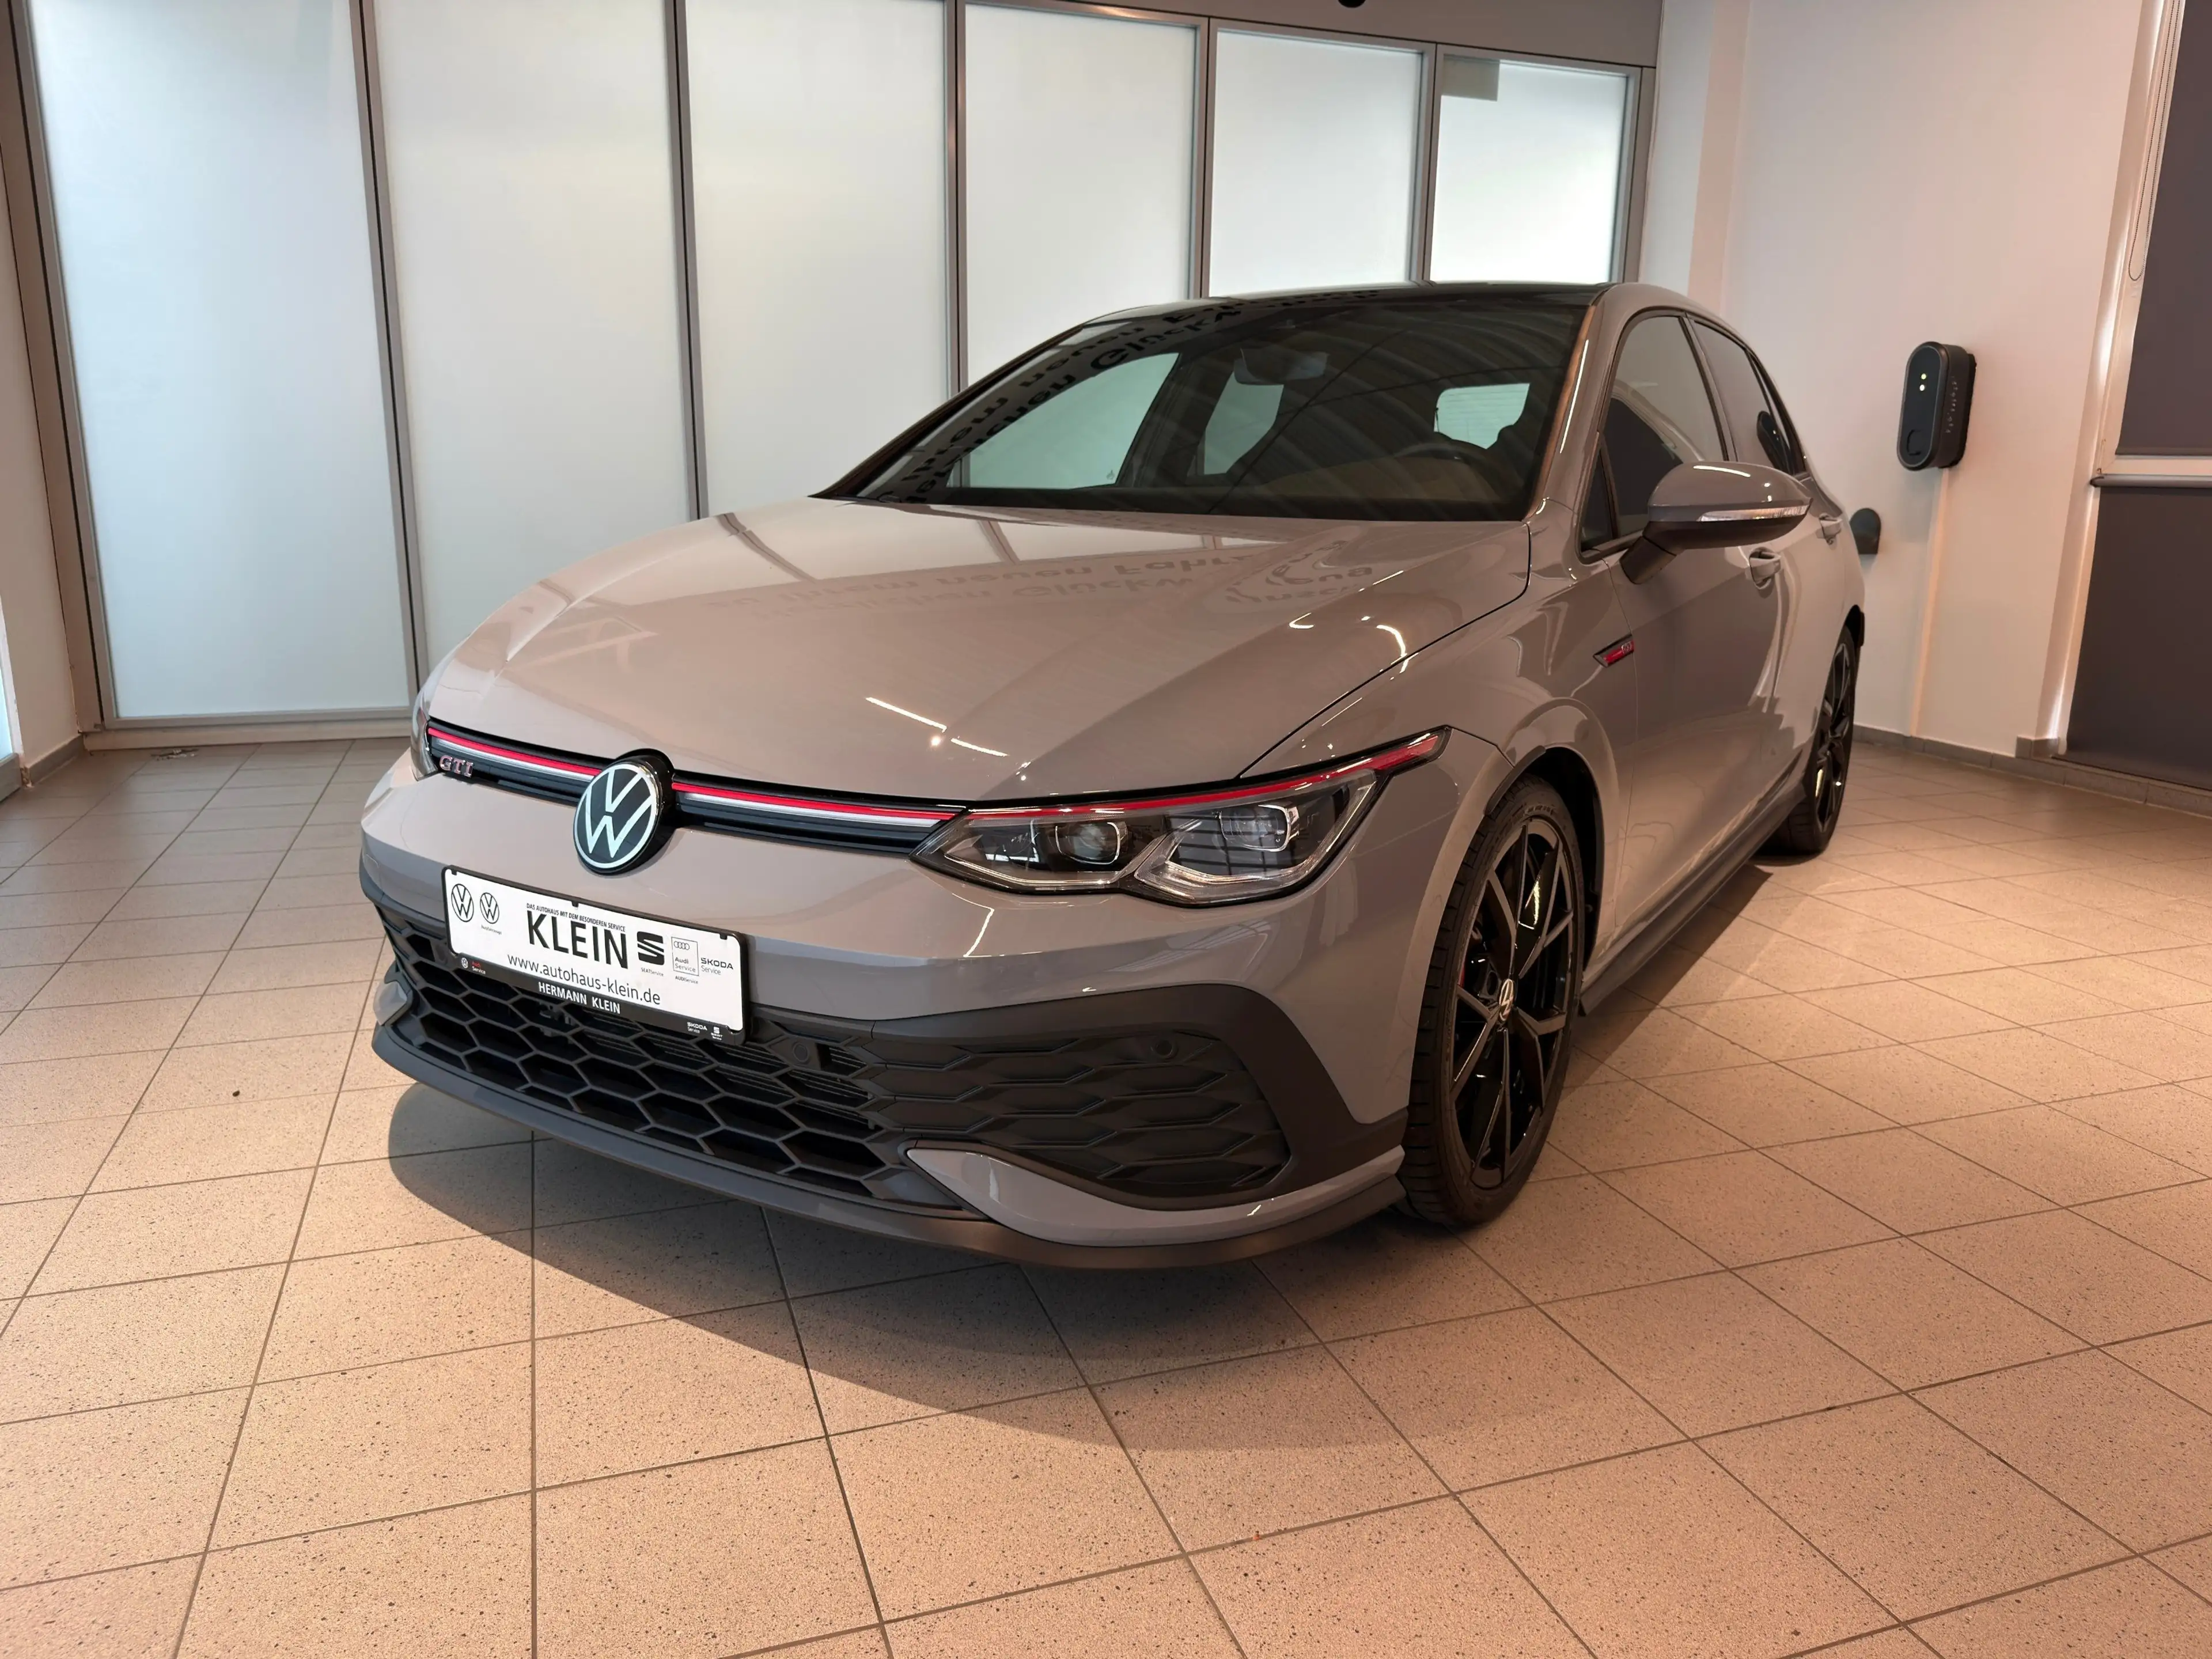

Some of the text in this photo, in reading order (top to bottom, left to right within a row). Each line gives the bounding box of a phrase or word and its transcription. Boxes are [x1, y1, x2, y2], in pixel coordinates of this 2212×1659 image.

[440, 755, 474, 778] GTI
[536, 905, 559, 915] AUTOHAUS
[579, 915, 607, 927] BESONDEREN
[608, 922, 626, 932] SERVICE
[527, 910, 628, 969] KLEIN
[472, 966, 486, 975] Service
[675, 956, 689, 965] Audi
[675, 963, 696, 972] Service
[700, 965, 721, 975] Service
[507, 954, 661, 1005] www.autohaus-klein.de
[538, 981, 620, 1014] HERMANN KLEIN
